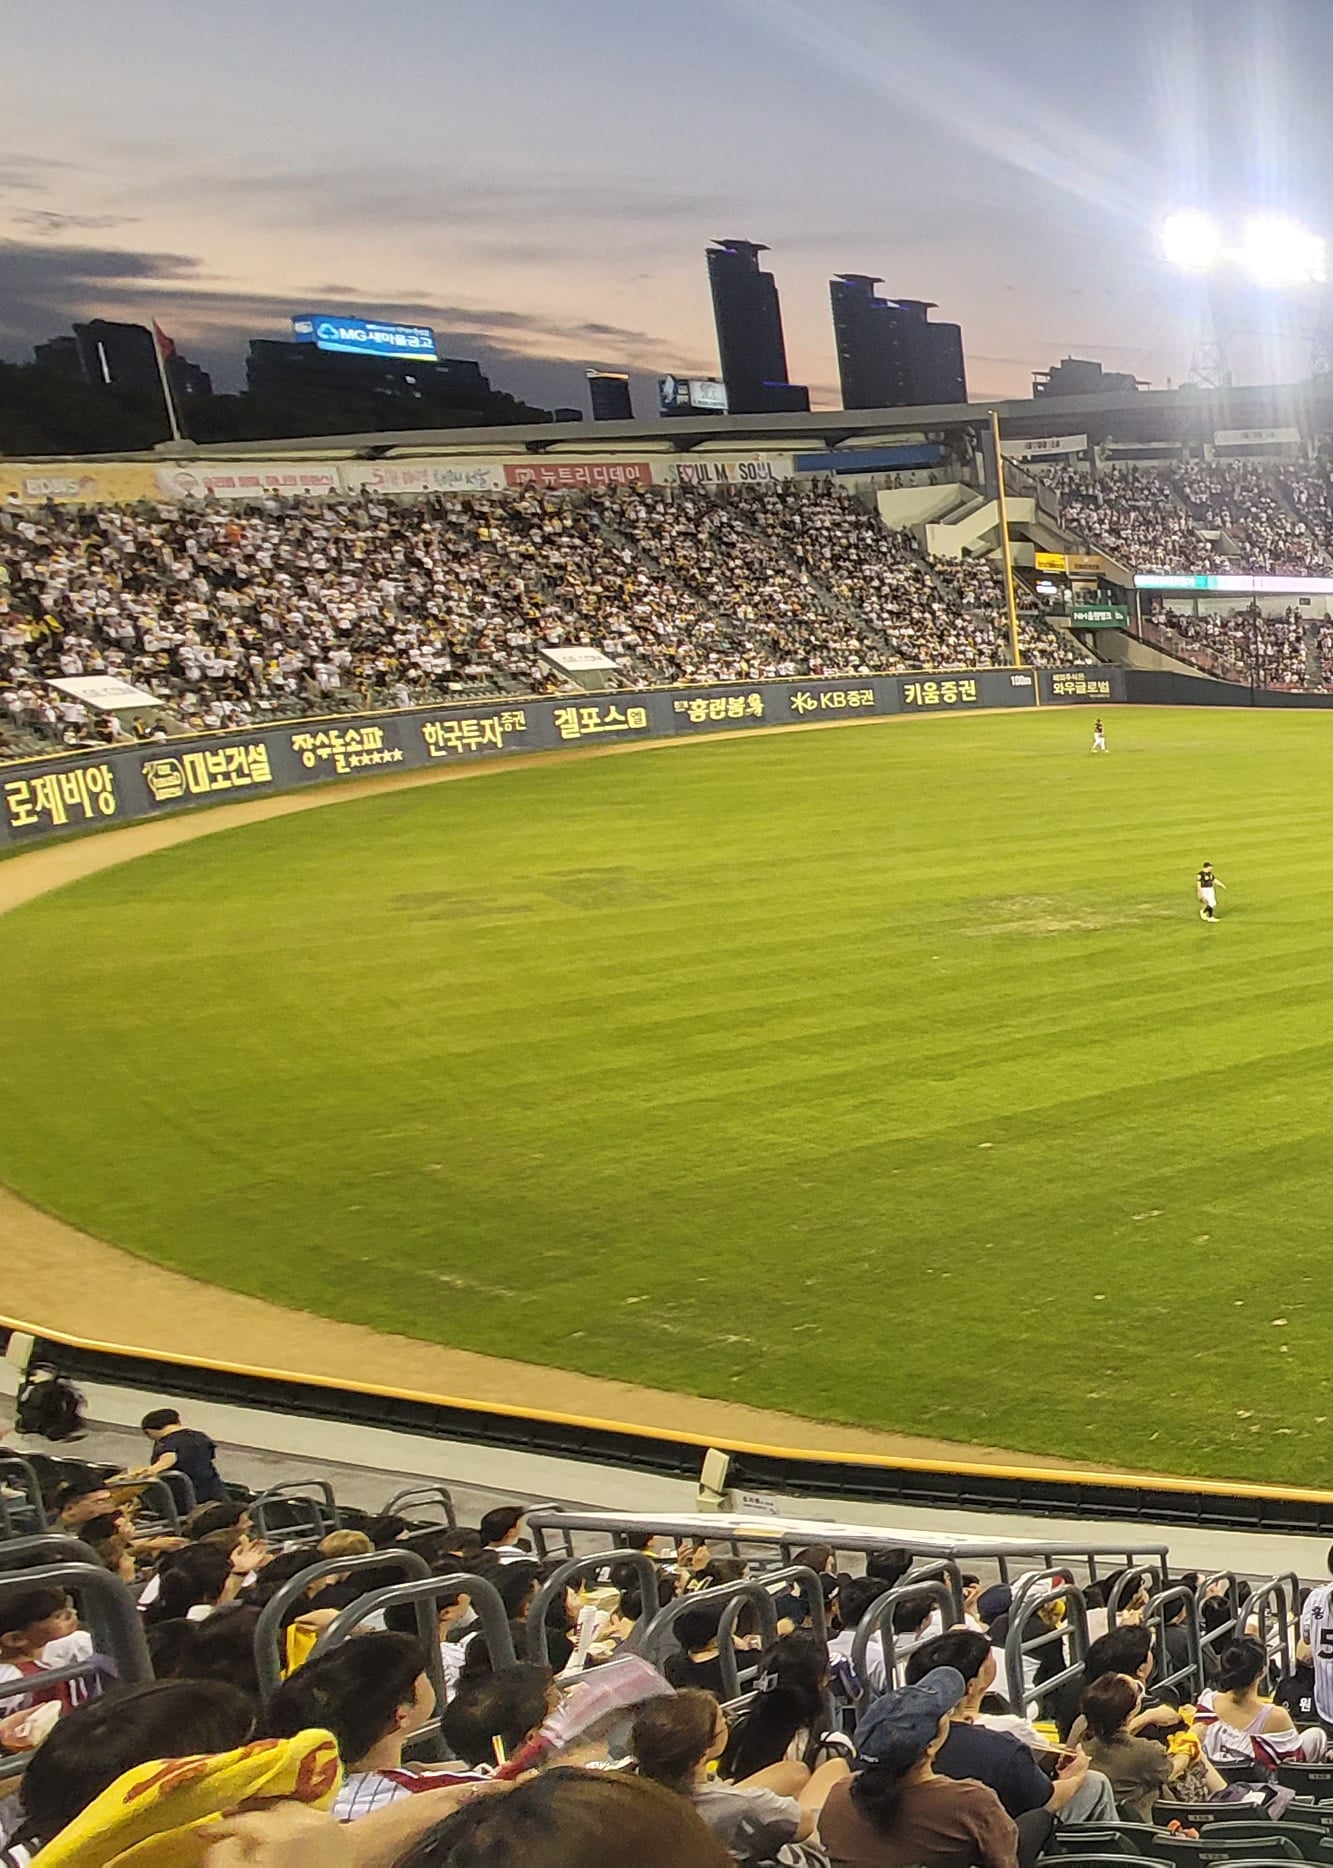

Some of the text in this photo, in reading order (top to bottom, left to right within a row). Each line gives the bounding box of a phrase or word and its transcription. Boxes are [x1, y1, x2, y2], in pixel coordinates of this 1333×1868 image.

[820, 689, 875, 709] KB증권
[903, 679, 977, 706] 키움증권
[1053, 681, 1111, 695] 와우글로벌
[3, 763, 117, 827] 로제비앙
